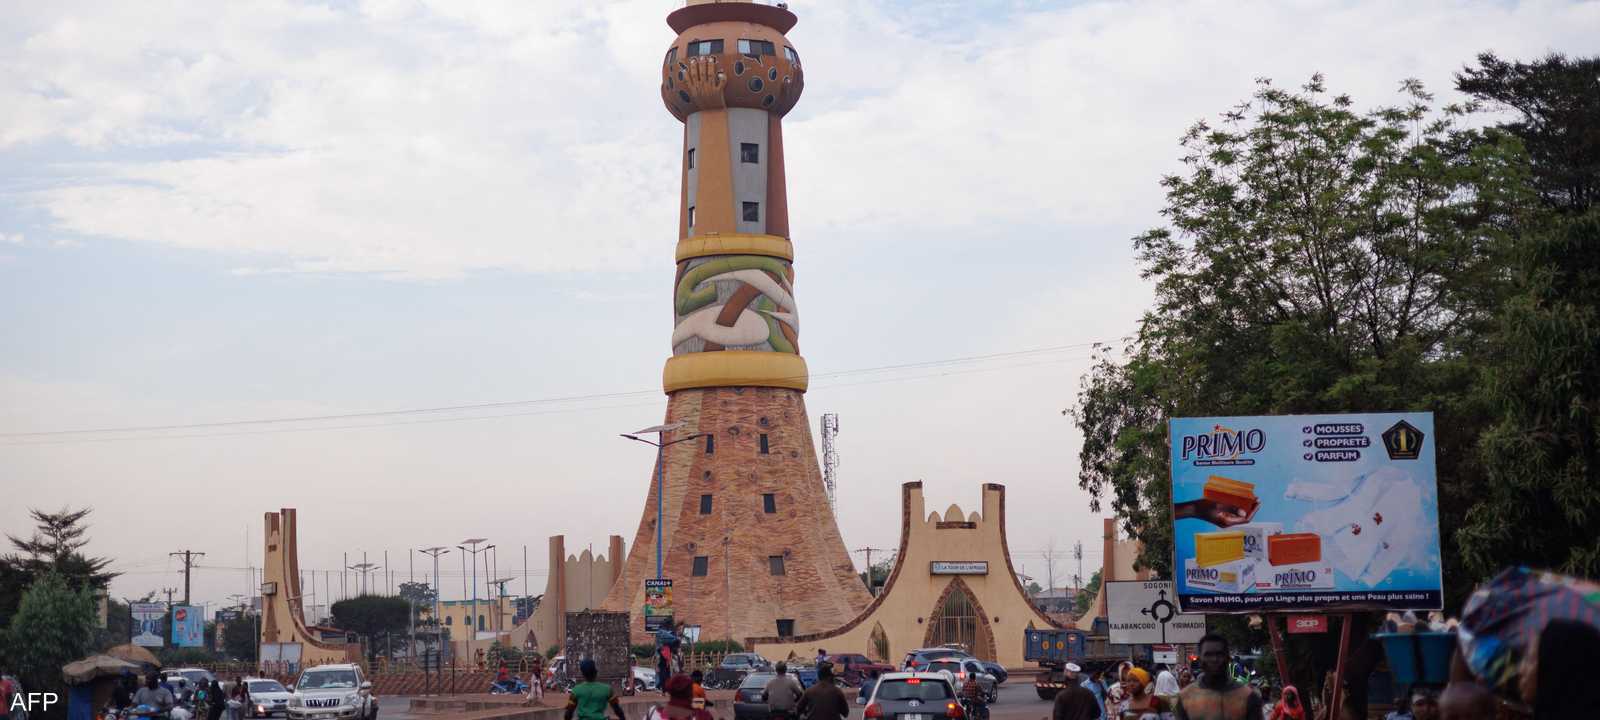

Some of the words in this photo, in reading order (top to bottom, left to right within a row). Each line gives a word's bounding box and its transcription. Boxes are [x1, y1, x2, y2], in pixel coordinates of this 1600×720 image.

[1316, 425, 1361, 434] MOUSSES
[1182, 428, 1267, 460] PRIMO
[1316, 438, 1368, 447] PROPRETÉ
[1317, 451, 1358, 460] PARFUM
[1186, 568, 1218, 581] PRIMO
[1275, 570, 1316, 585] PRIMO
[1214, 596, 1244, 604] PRIMO,
[1244, 596, 1263, 604] pour
[1297, 595, 1313, 603] plus
[1387, 593, 1403, 602] plus
